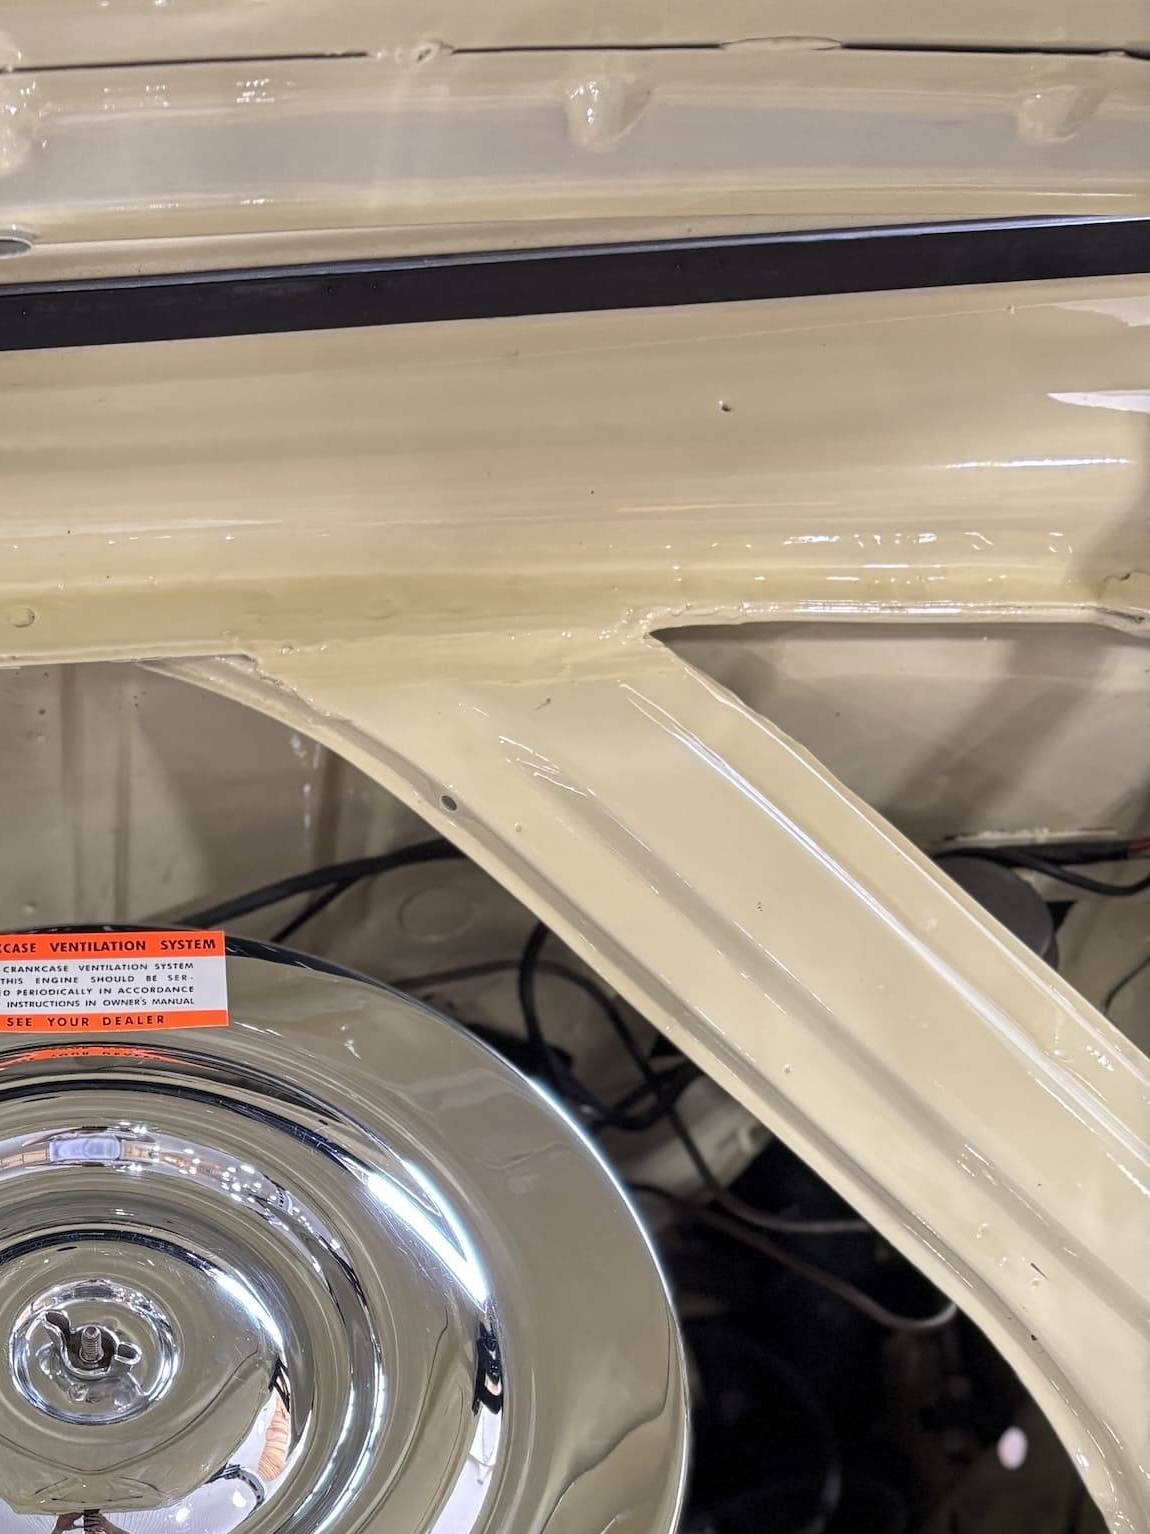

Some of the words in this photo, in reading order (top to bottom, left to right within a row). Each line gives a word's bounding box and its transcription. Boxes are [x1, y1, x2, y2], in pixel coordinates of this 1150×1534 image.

[50, 941, 146, 952] VENTILATION
[160, 939, 216, 951] SYSTEM
[17, 988, 92, 996] PERIODICALLY
[118, 986, 194, 994] ACCORDANCE
[7, 999, 80, 1008] INSTRUCTIONS
[103, 997, 147, 1006] OWNER'S
[152, 997, 194, 1005] MANUAL
[7, 1017, 32, 1027] SEE
[47, 1017, 90, 1027] YOUR
[102, 1015, 165, 1026] DEALER
